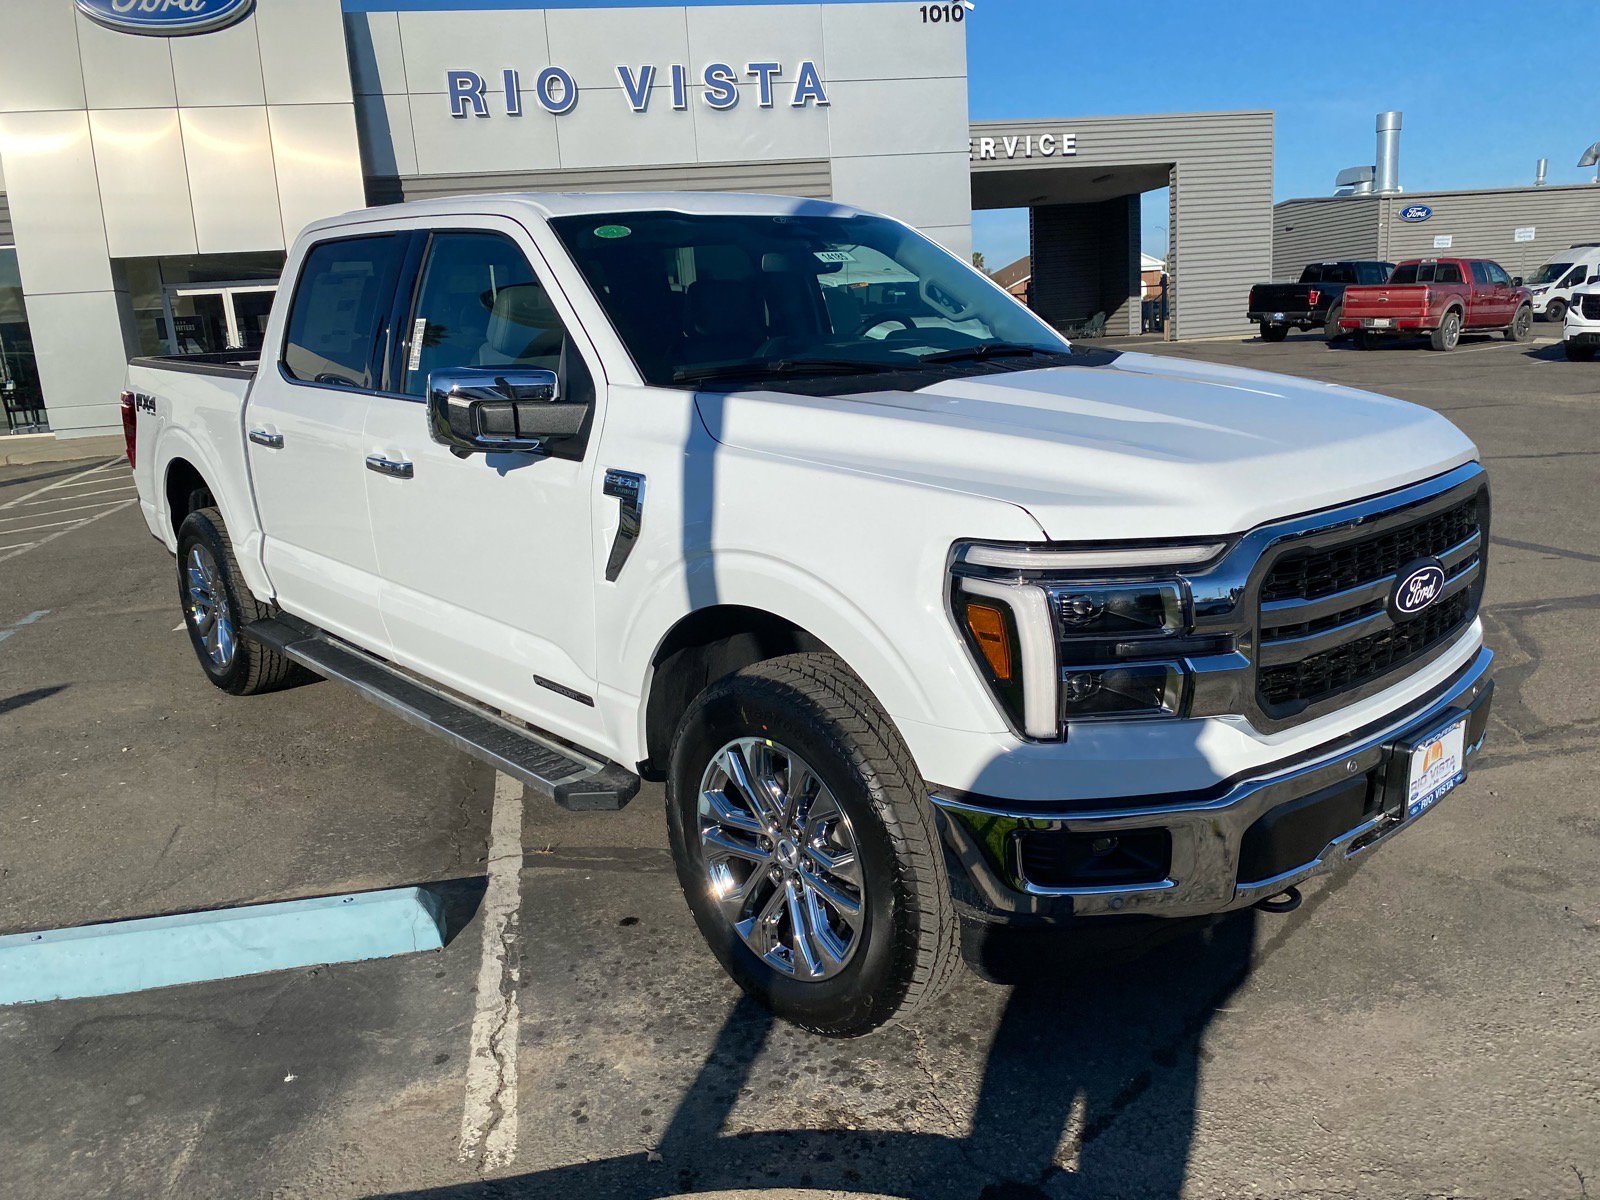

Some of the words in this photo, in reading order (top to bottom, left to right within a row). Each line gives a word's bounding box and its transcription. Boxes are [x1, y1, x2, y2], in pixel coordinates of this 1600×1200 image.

[919, 5, 964, 23] 1010
[446, 65, 577, 118] RIO
[615, 60, 830, 112] VISTA
[969, 133, 1077, 161] RVICE
[1405, 572, 1437, 608] Ford
[1420, 794, 1434, 809] RIO
[1435, 780, 1454, 799] VISTA
